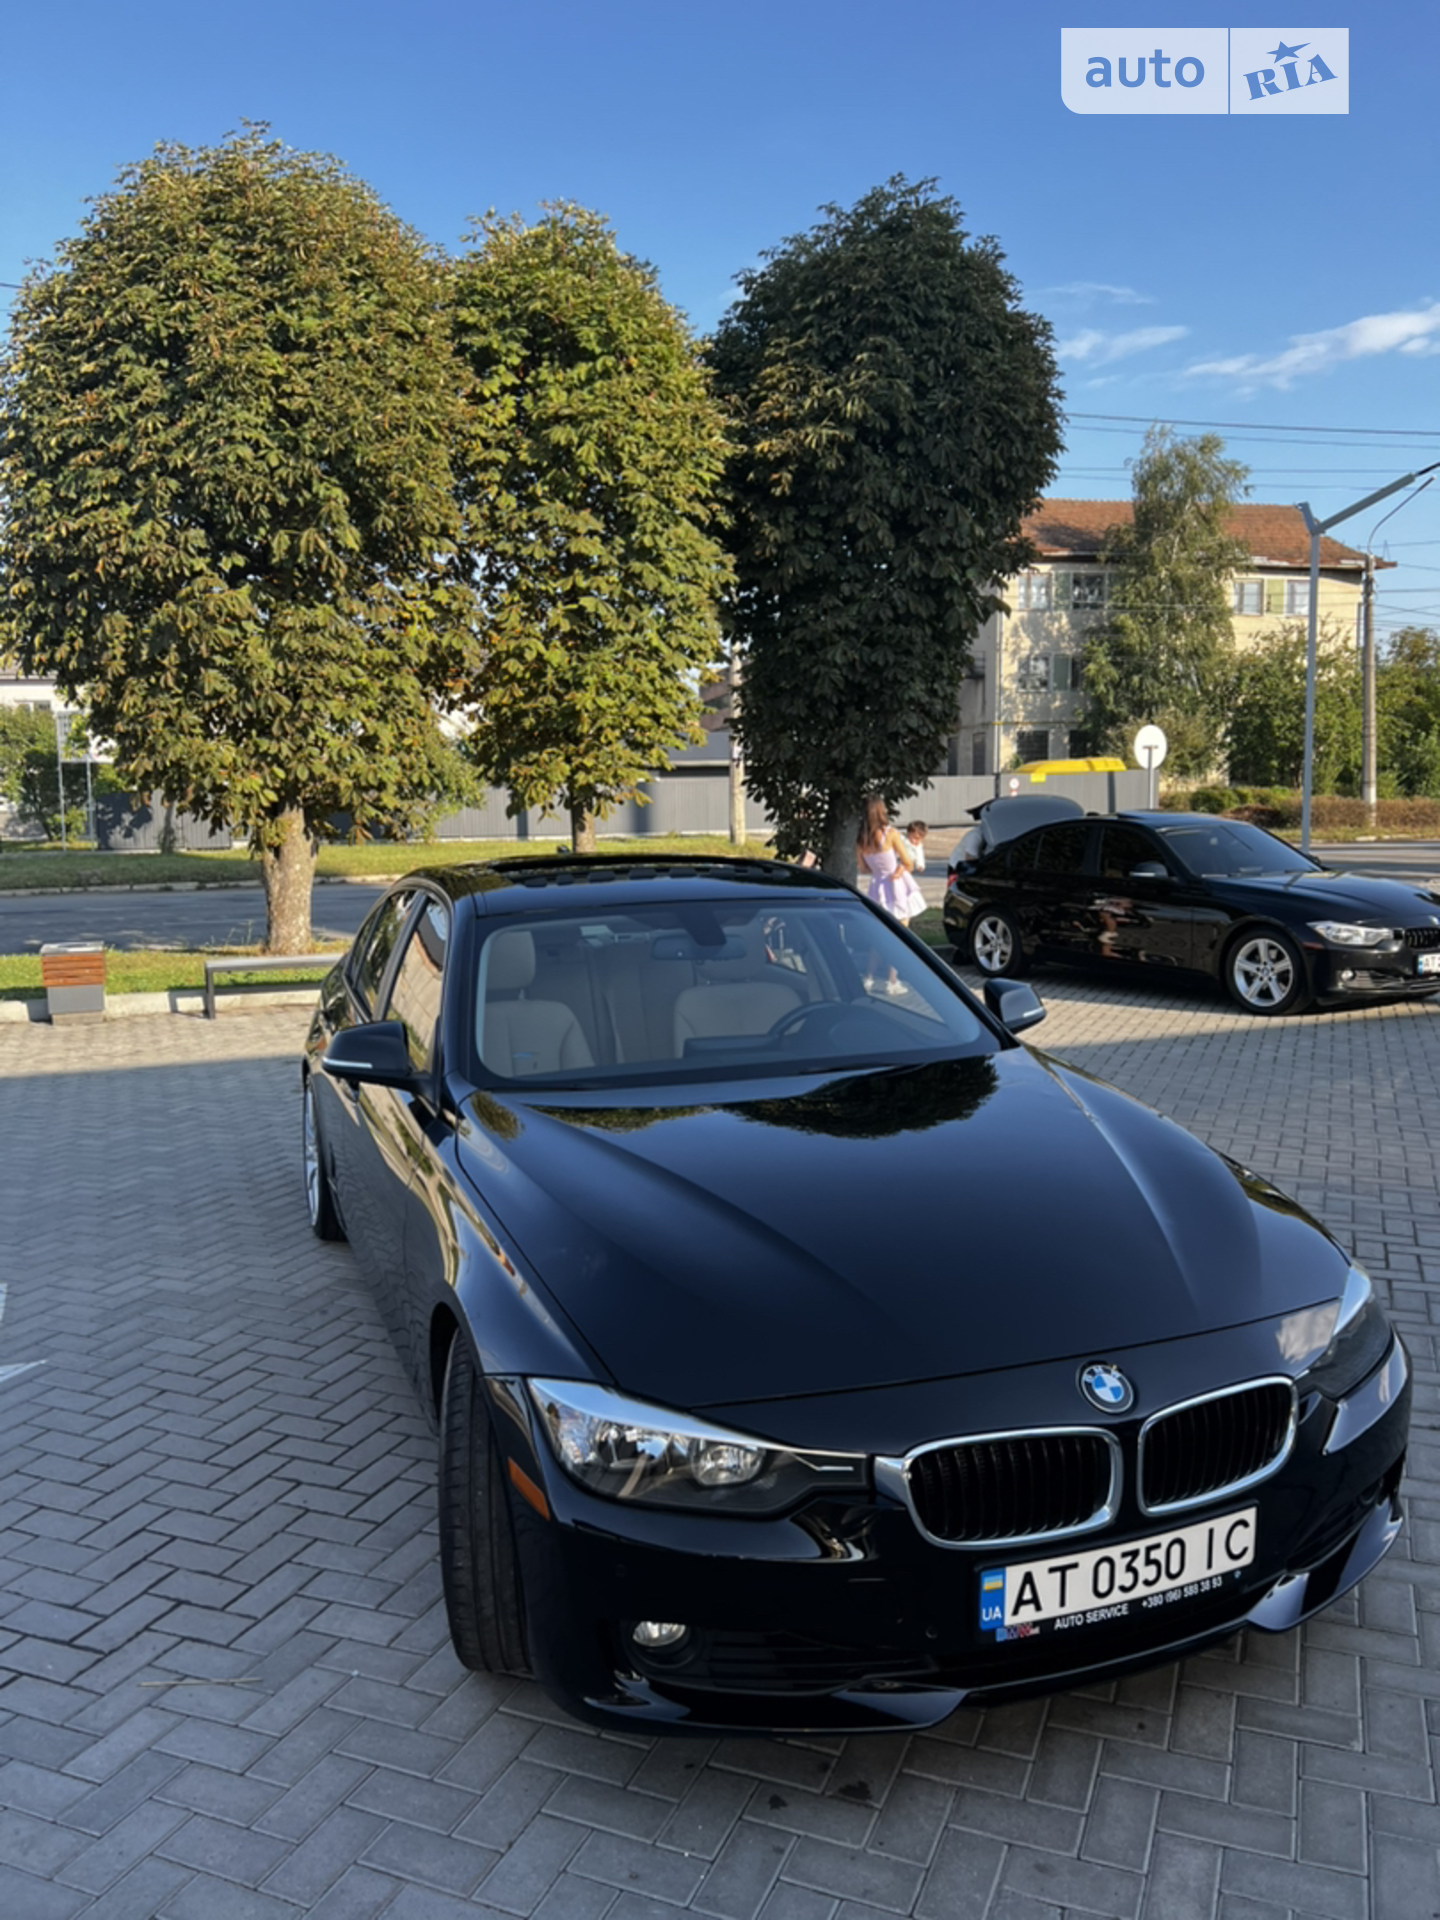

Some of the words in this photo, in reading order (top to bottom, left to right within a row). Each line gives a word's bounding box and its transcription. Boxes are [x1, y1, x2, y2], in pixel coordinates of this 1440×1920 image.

[1011, 1562, 1079, 1617] AT
[1092, 1537, 1186, 1599] 0350
[1206, 1519, 1250, 1570] IC
[982, 1606, 1002, 1622] UA
[1054, 1613, 1084, 1631] AUTO
[1086, 1603, 1129, 1624] SERVICE
